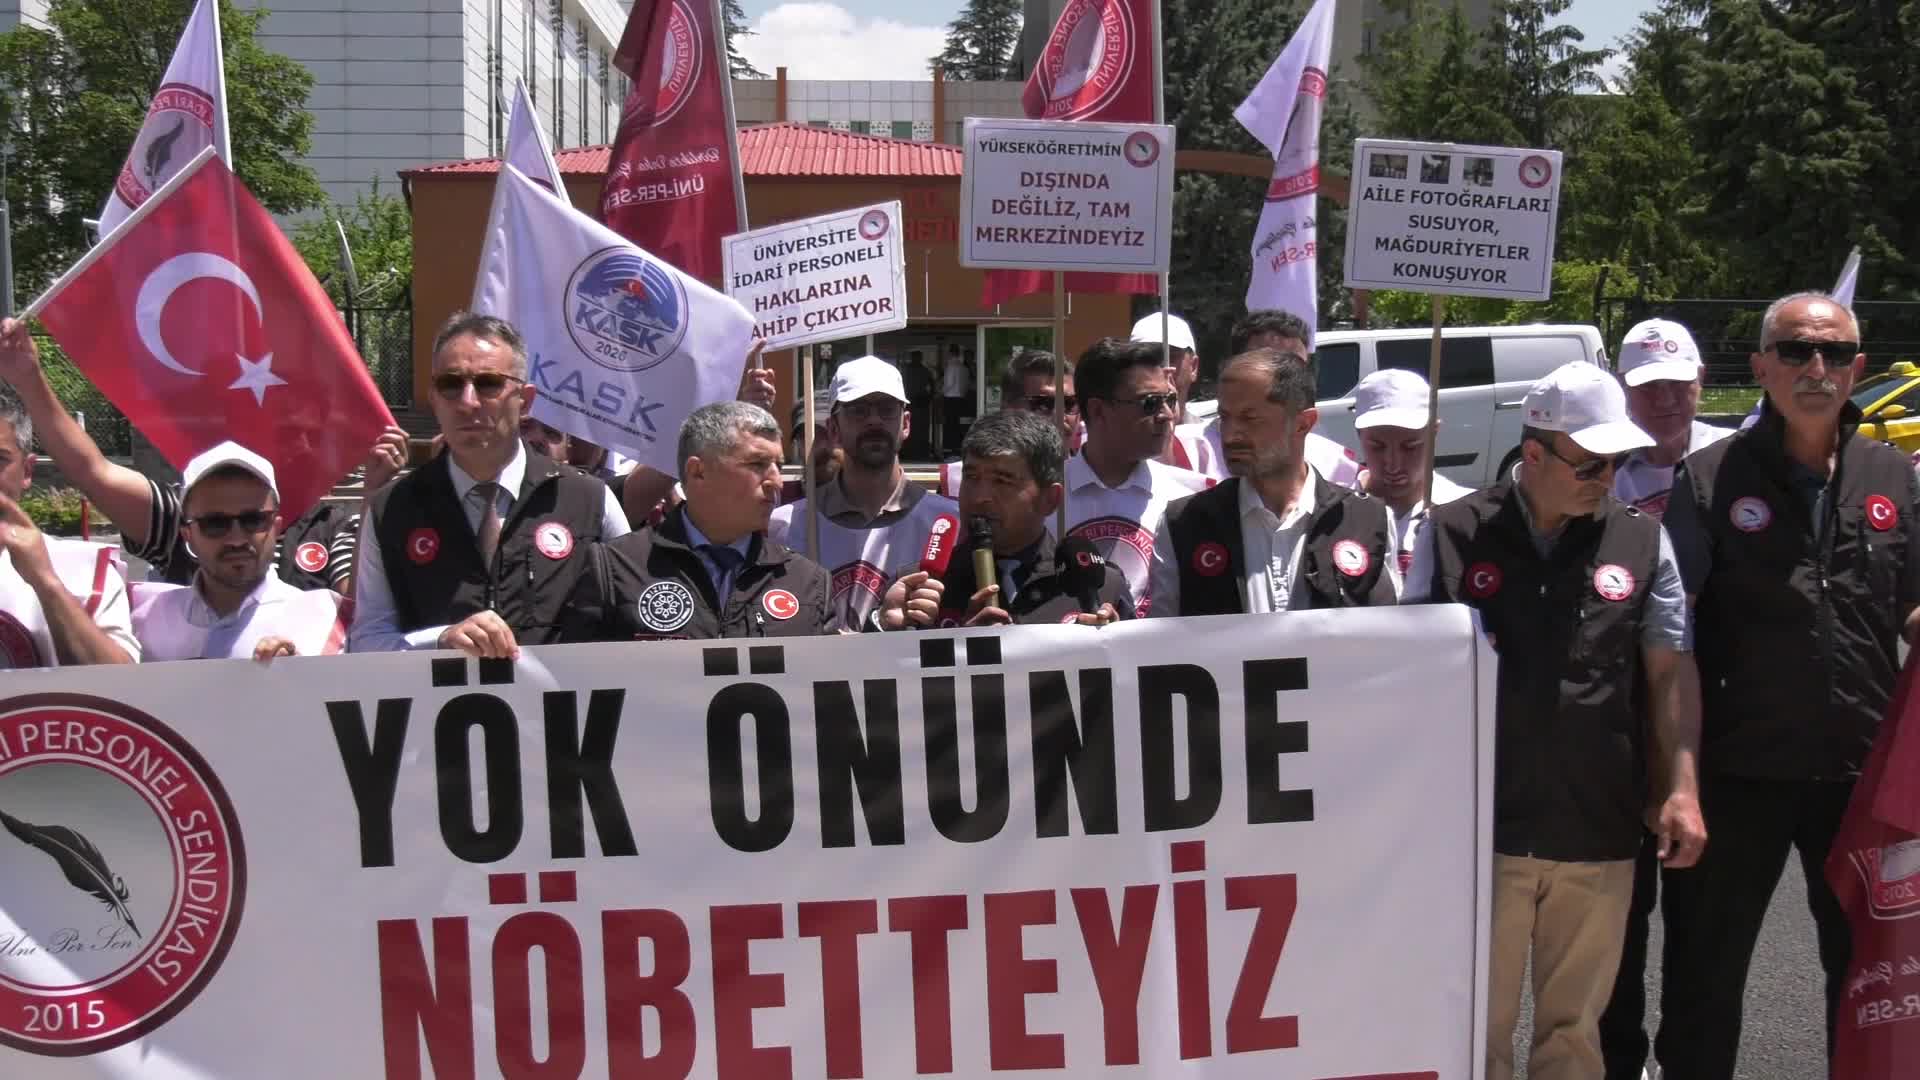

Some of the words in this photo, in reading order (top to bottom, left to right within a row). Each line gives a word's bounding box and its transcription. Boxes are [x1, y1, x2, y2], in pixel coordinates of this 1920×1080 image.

[979, 138, 1121, 157] YÜKSEKÖĞRETİMİN
[1020, 171, 1110, 192] DIŞINDA
[991, 194, 1082, 220] DEĞİLİZ,
[1088, 201, 1130, 218] TAM
[1362, 184, 1405, 204] AİLE
[1410, 188, 1551, 213] FOTOĞRAFLARI
[976, 224, 1145, 247] MERKEZİNDEYİZ
[1408, 214, 1500, 237] SUSUYOR,
[753, 228, 857, 262] ÜNİVERSİTE
[1375, 234, 1530, 261] MAĞDURİYETLER
[733, 263, 784, 288] İDARİ
[788, 241, 885, 276] PERSONELİ
[1393, 262, 1508, 284] KONUŞUYOR
[755, 273, 872, 312] HAKLARINA
[575, 302, 665, 355] KASK
[750, 316, 798, 340] AHİP
[804, 297, 893, 331] ÇIKIYOR
[529, 352, 665, 433] KASK
[928, 534, 941, 560] anka
[703, 636, 1314, 853] ÖNÜNDE
[325, 657, 639, 868] YÖK
[19, 721, 188, 811] PERSONEL
[145, 809, 218, 987] SENDİKASI
[377, 840, 1299, 1080] NÖBETTEYİZ
[23, 1000, 105, 1032] 2015
